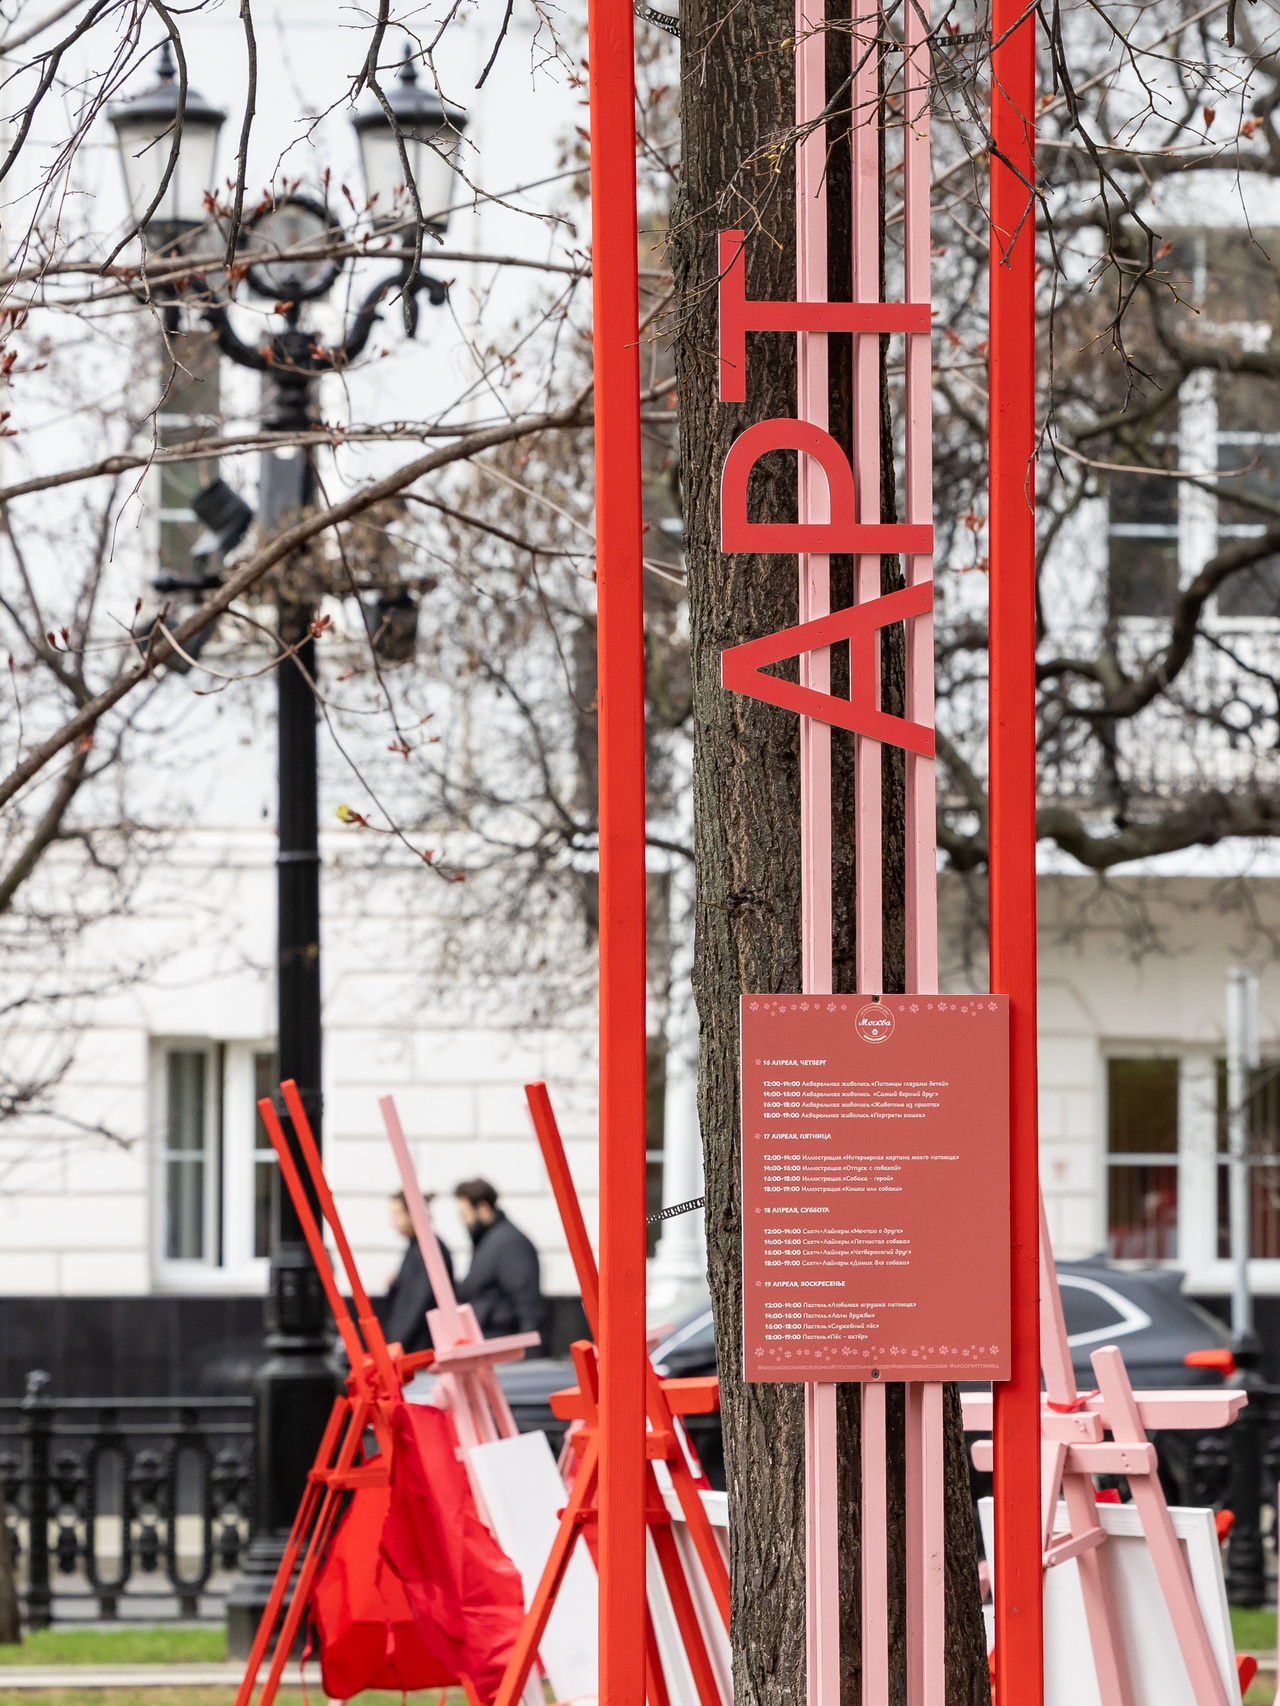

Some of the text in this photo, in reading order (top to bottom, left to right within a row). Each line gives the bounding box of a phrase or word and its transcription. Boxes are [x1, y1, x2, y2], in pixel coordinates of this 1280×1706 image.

[719, 229, 935, 758] АРТ
[858, 1018, 891, 1027] Москва
[802, 1090, 840, 1098] Акварельная
[899, 1090, 920, 1098] верный
[801, 1111, 839, 1119] Акварельная
